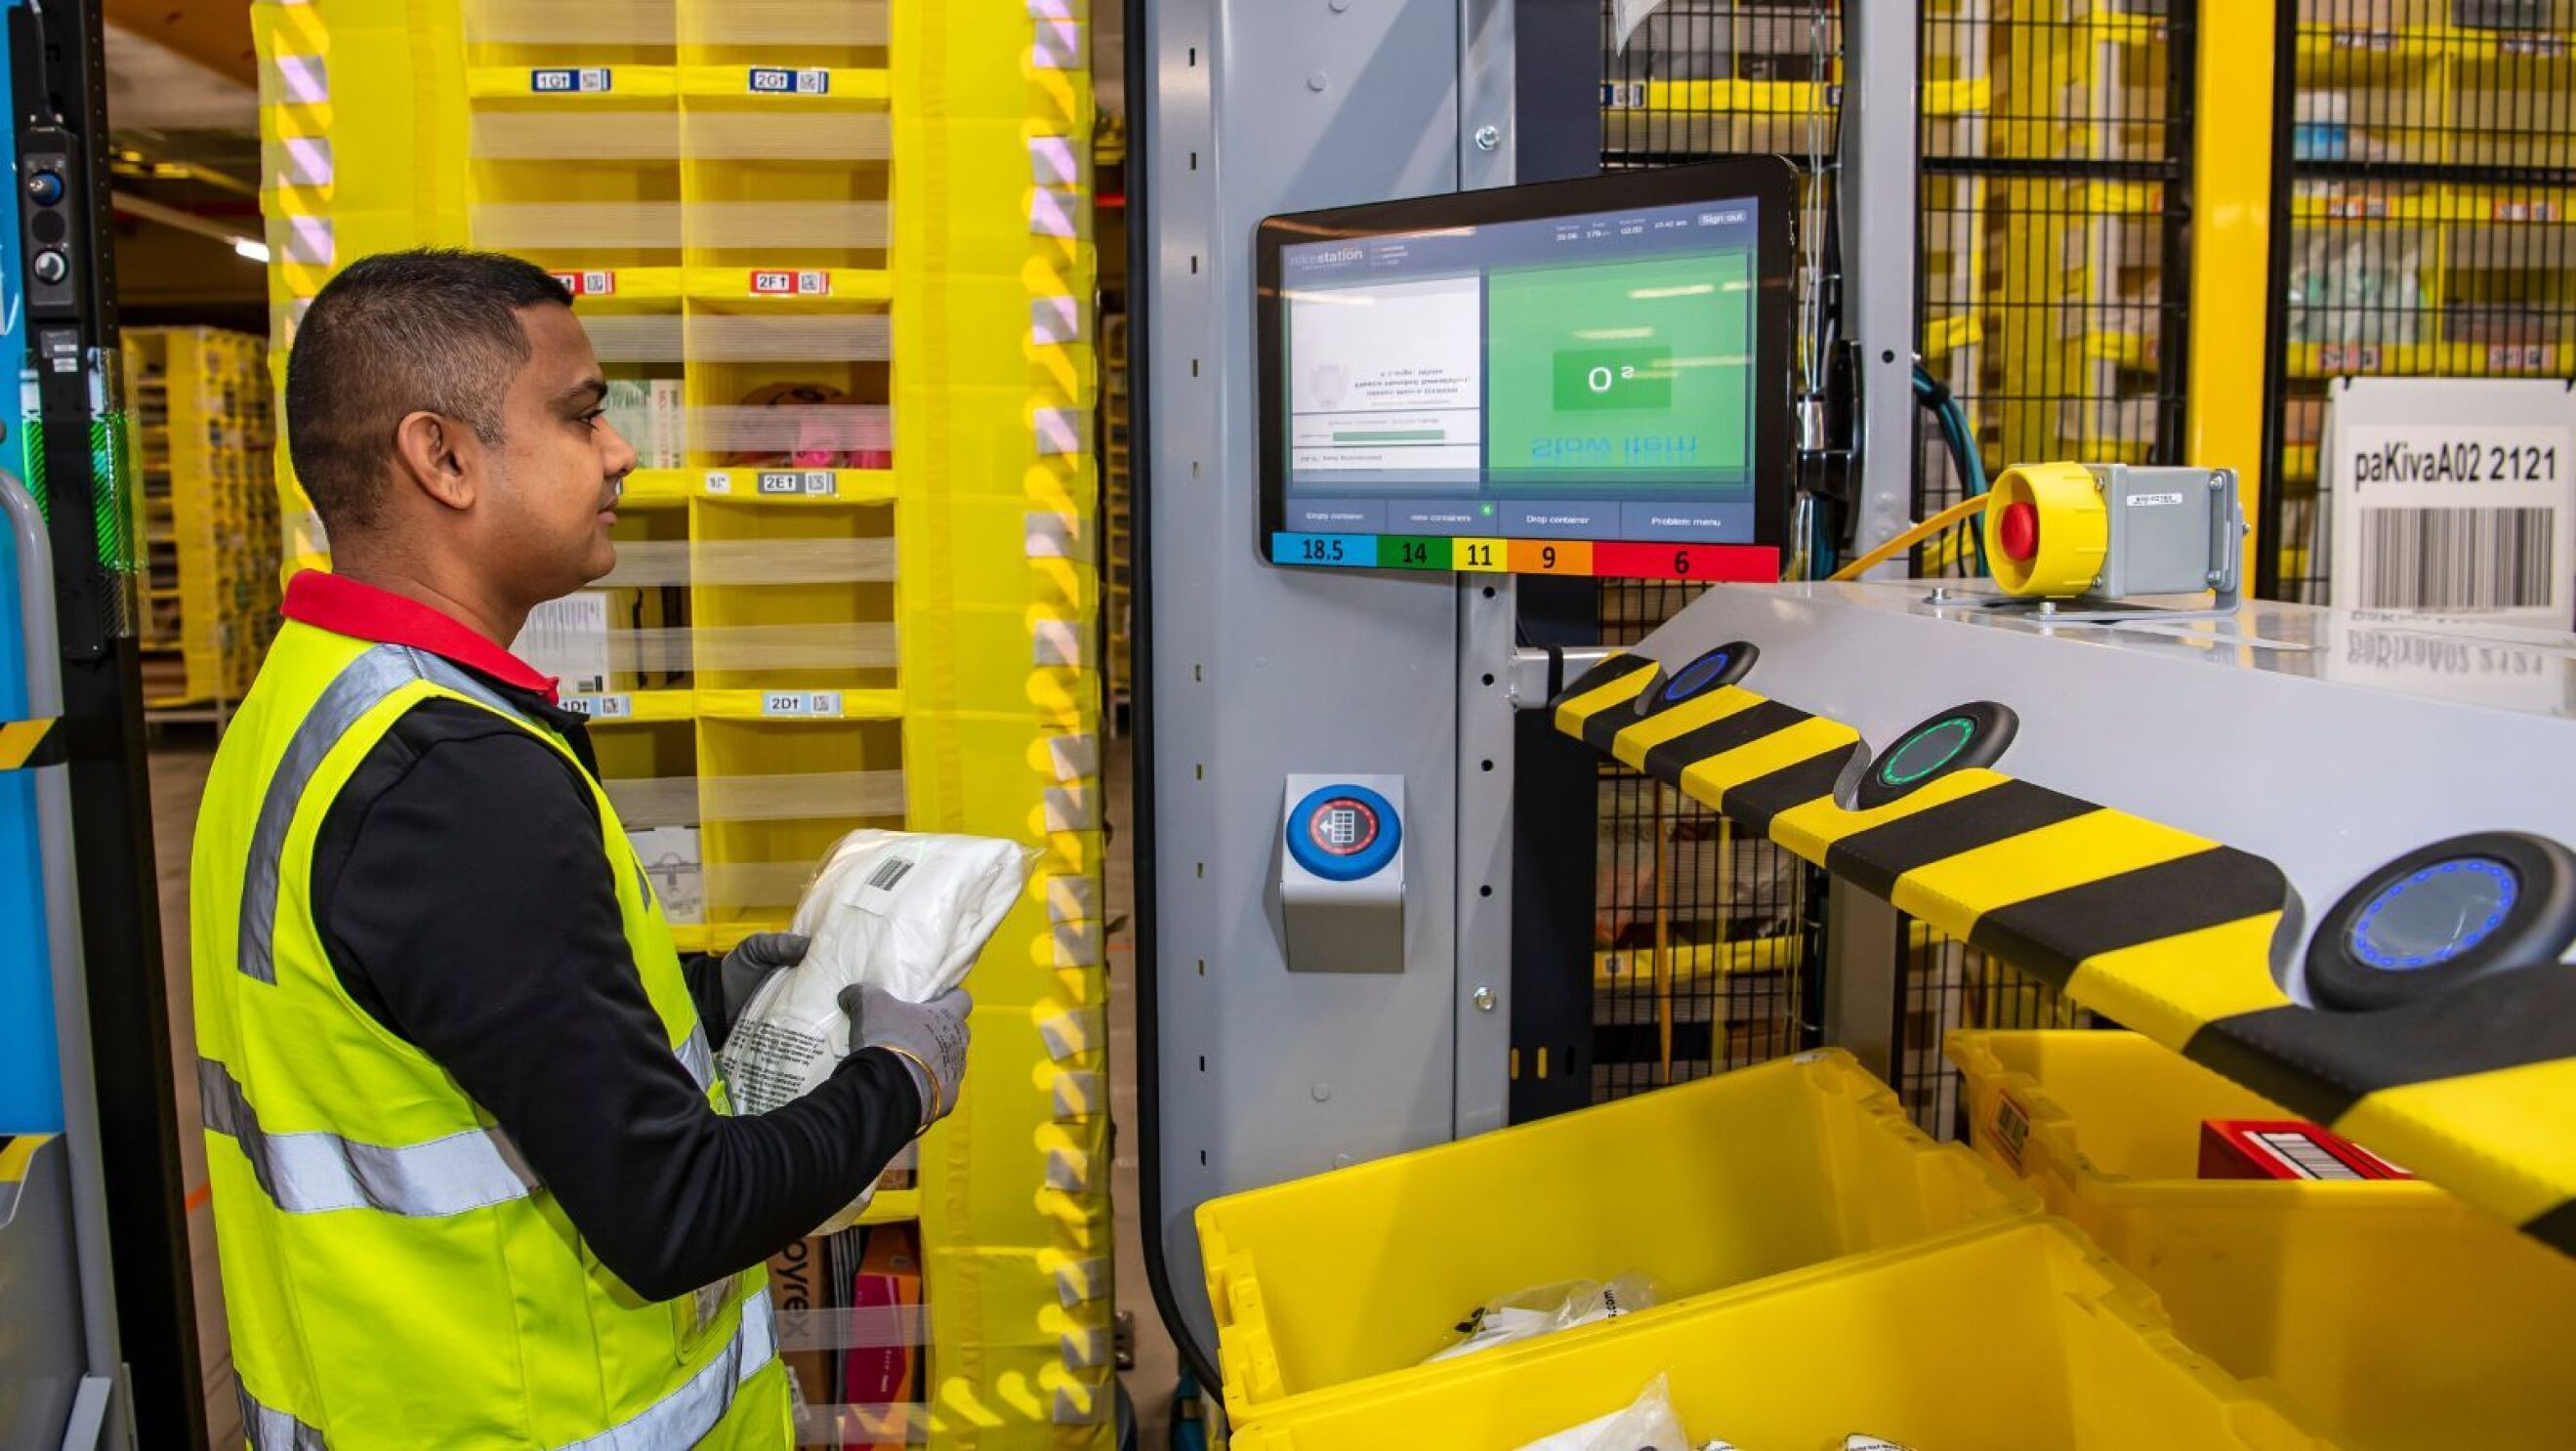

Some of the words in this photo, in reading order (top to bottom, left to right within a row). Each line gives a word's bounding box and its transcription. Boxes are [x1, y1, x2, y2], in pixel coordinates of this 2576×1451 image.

[2354, 441, 2481, 493] paKivaA02
[2489, 445, 2555, 481] 2121
[1525, 515, 1548, 525] Drop
[1550, 516, 1590, 524] container
[1651, 517, 1691, 526] Problem
[1692, 518, 1722, 527] menu
[1304, 539, 1344, 560] 18.5
[1403, 542, 1428, 564] 14
[1468, 544, 1493, 566] 11
[1542, 547, 1557, 569] 9
[1674, 550, 1689, 574] 6
